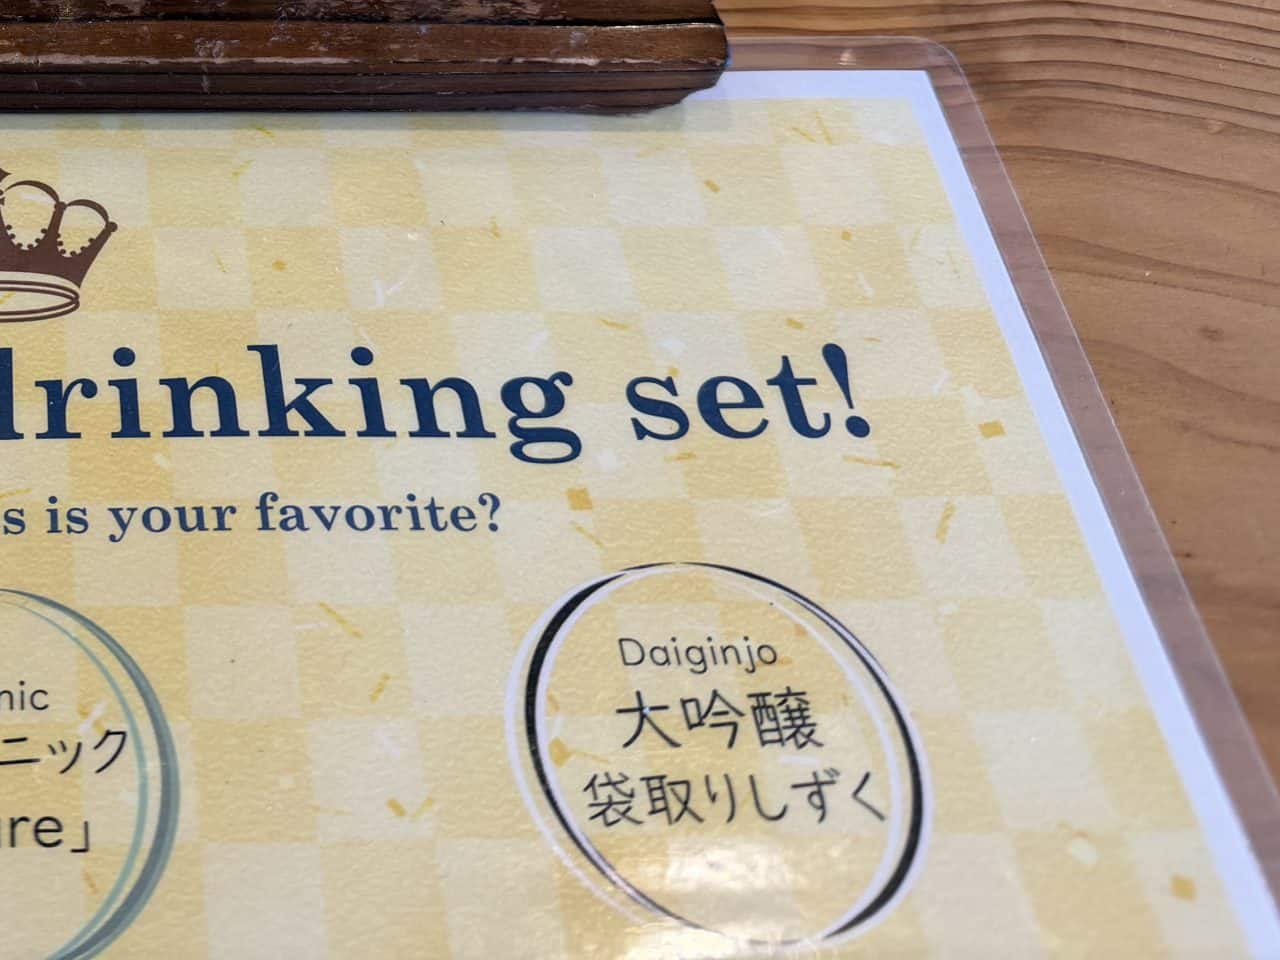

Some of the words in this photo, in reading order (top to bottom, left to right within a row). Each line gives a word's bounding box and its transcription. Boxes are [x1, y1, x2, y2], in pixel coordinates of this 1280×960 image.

[625, 343, 871, 441] set!
[45, 495, 89, 535] is
[107, 504, 237, 543] your
[255, 491, 502, 533] favorite?
[618, 636, 778, 675] Daiginjo
[615, 686, 824, 749] 大吟醸
[582, 768, 885, 828] 袋取りしずく
